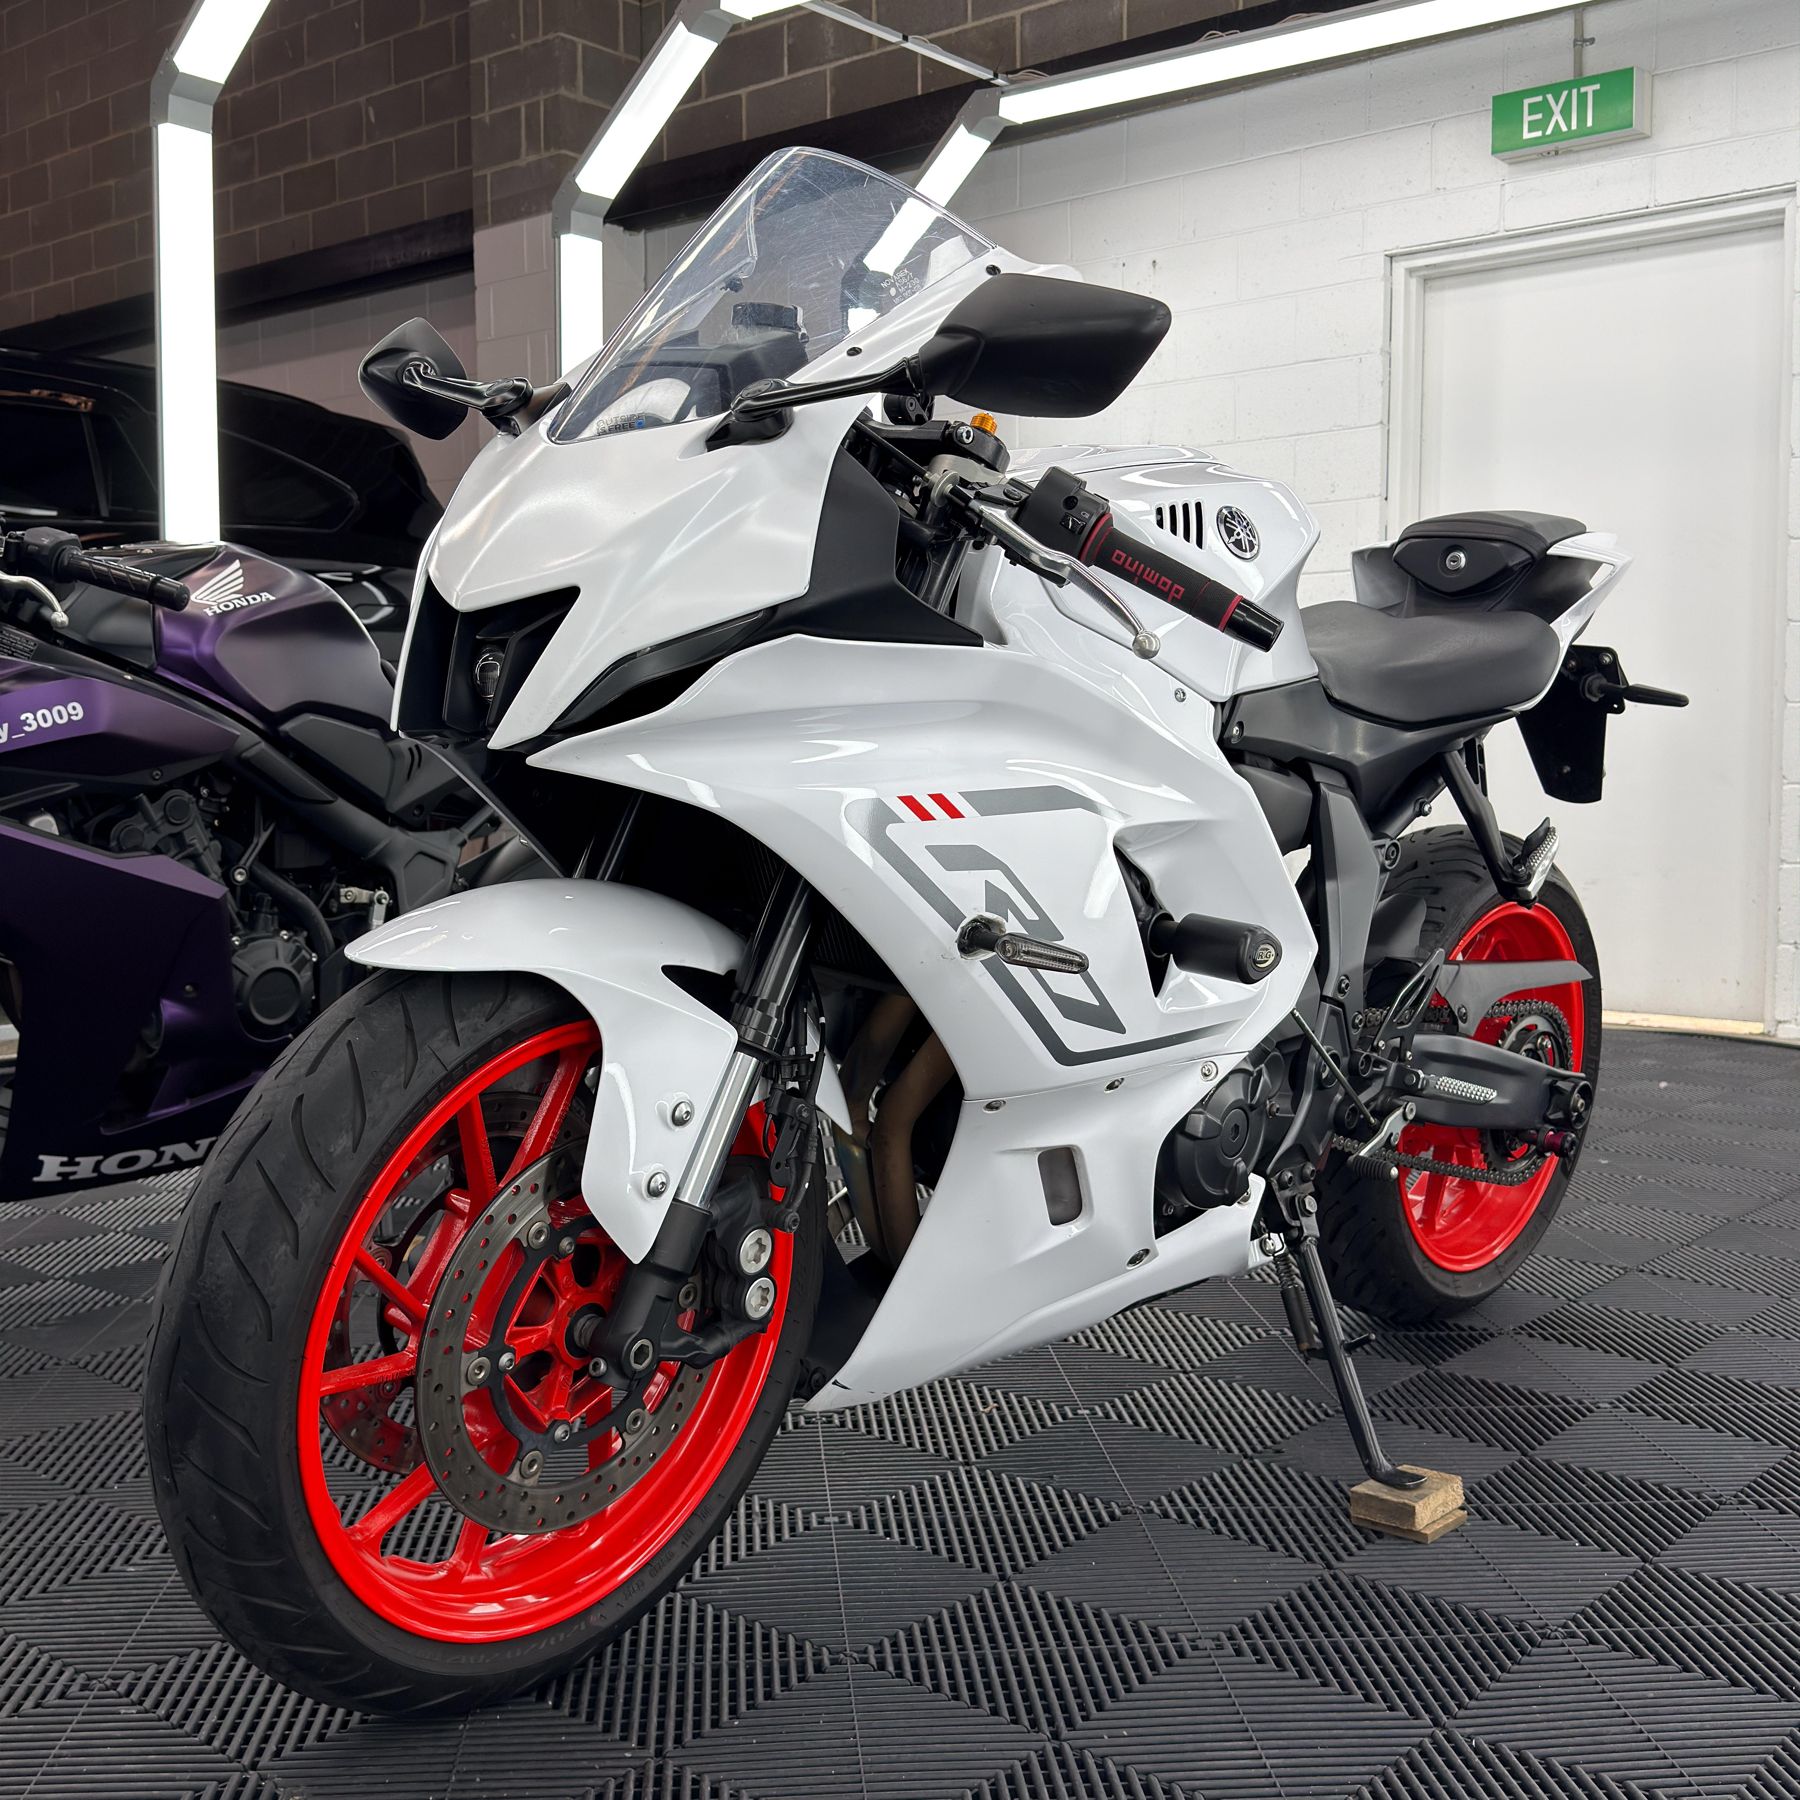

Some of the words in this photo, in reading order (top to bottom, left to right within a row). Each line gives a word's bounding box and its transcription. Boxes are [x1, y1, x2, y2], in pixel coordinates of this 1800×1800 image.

[1522, 83, 1600, 140] EXIT
[880, 268, 909, 288] NOVAREX
[596, 411, 646, 427] OUTSIDE
[608, 420, 636, 432] FREE
[1110, 548, 1186, 604] domino
[203, 591, 276, 617] HONDA
[0, 701, 84, 743] y_3009
